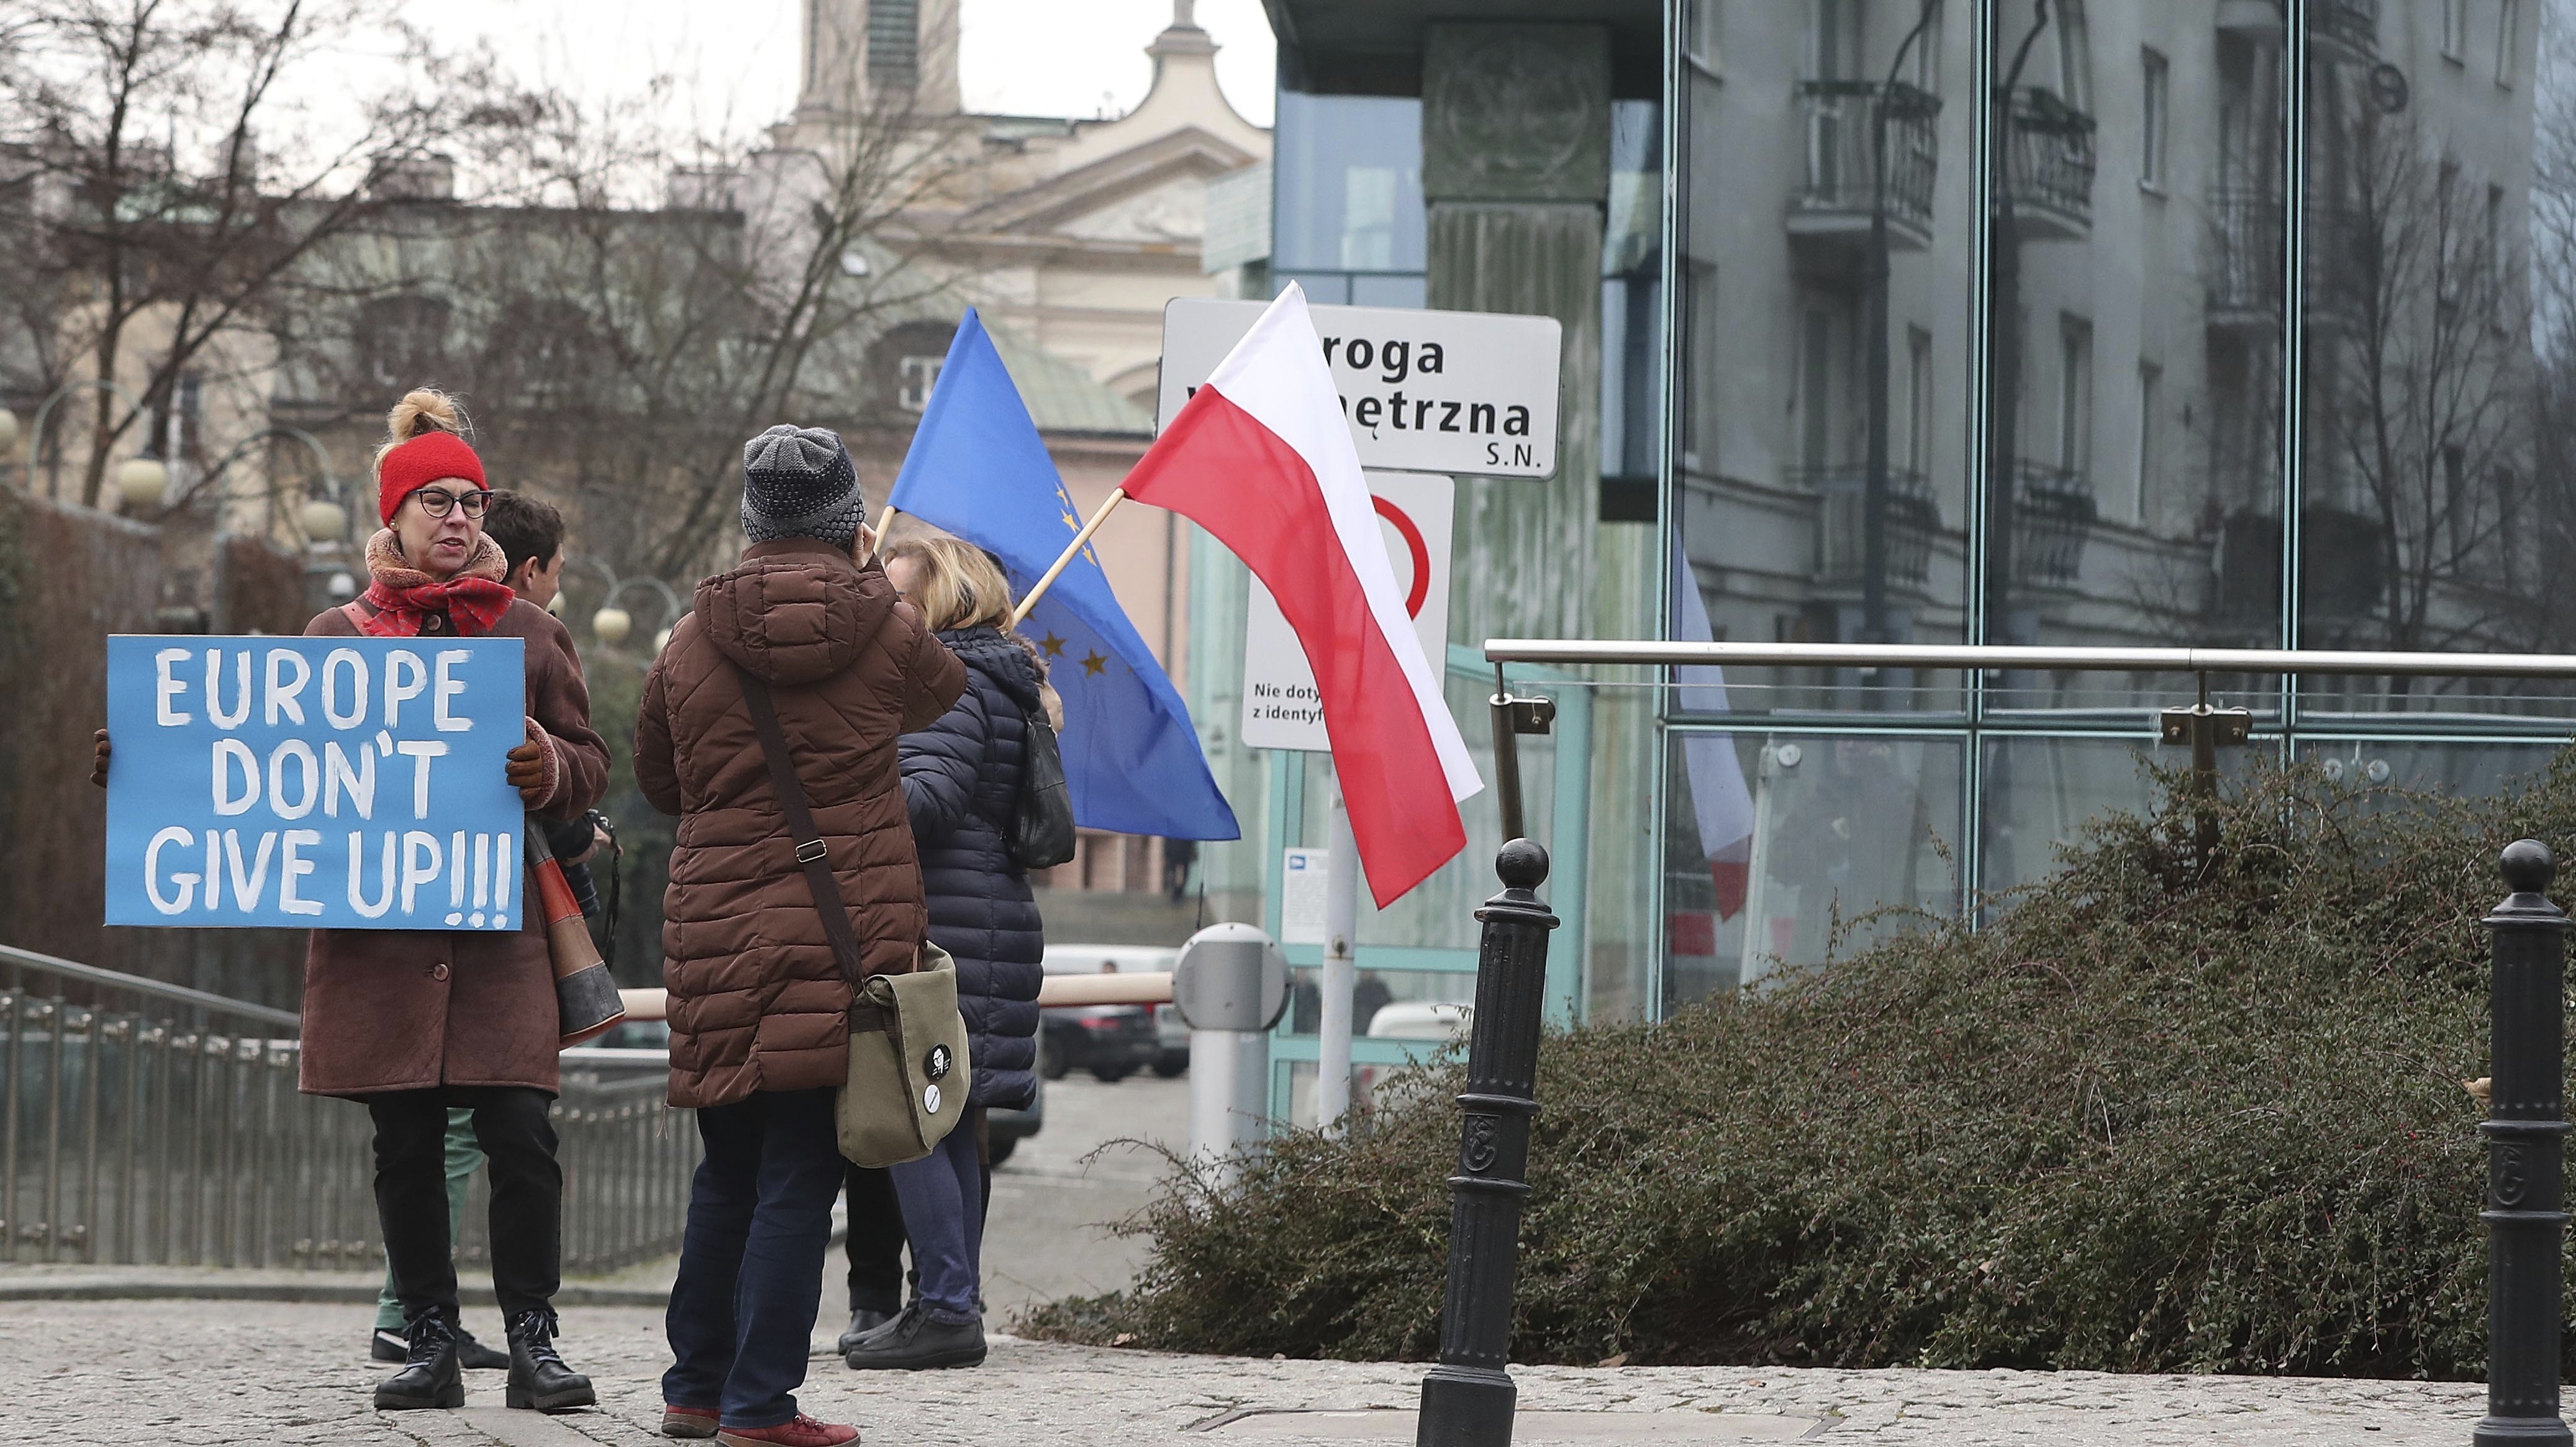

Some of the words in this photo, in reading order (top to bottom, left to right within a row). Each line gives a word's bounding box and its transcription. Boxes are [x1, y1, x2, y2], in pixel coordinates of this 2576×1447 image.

[1323, 337, 1444, 384] roga
[1485, 442, 1541, 468] S.N.
[155, 647, 475, 732] EUROPE
[1254, 683, 1281, 697] Nie
[1286, 684, 1320, 703] doty
[1253, 708, 1261, 718] z
[1266, 704, 1323, 725] identyf
[212, 728, 451, 820] DON'T
[144, 826, 325, 916] GIVE
[347, 829, 512, 930] UP!!!
